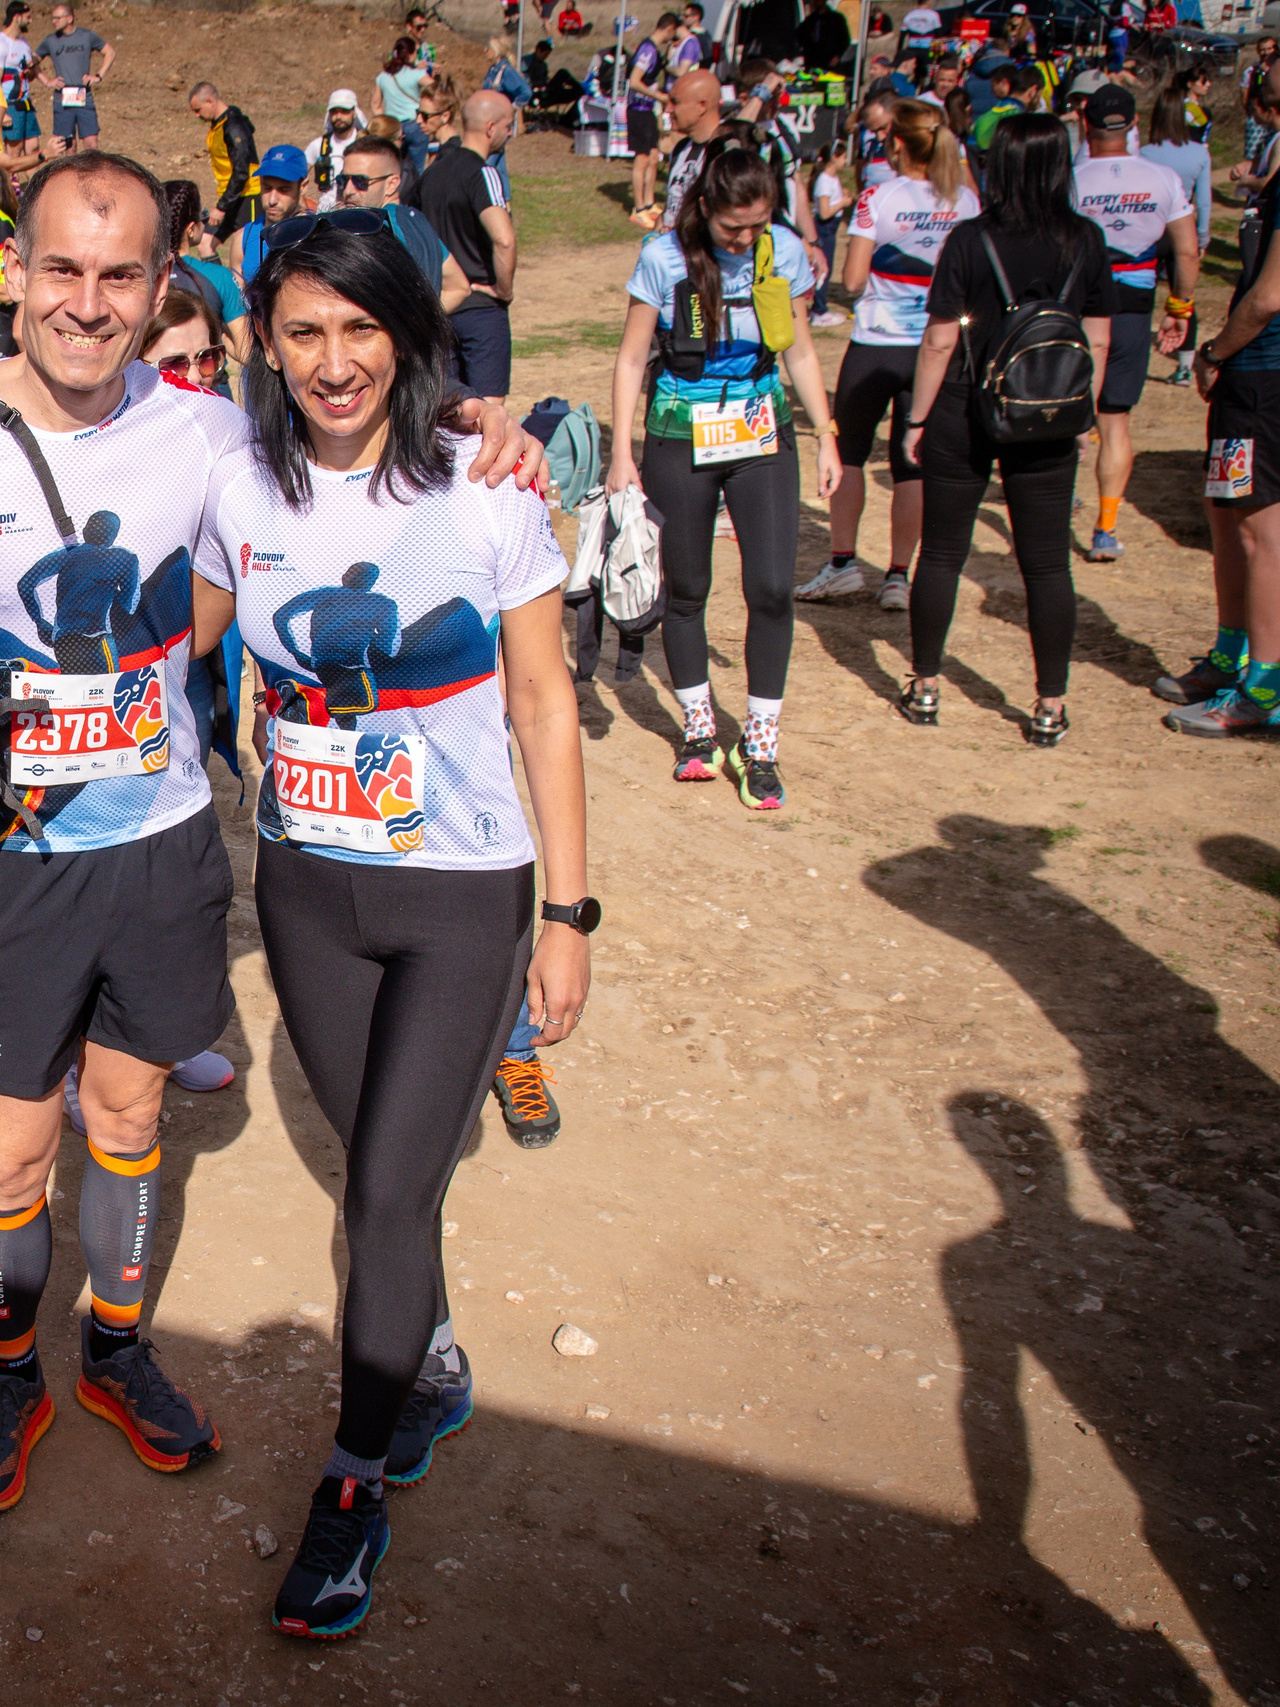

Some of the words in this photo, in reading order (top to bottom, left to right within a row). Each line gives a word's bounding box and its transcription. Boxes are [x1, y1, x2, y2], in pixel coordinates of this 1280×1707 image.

[1081, 194, 1120, 207] EVERY
[1120, 192, 1151, 203] STEP
[1103, 203, 1158, 215] MATTERS
[895, 212, 932, 222] EVERY
[931, 211, 958, 221] STEP
[914, 222, 958, 231] MATTER
[74, 428, 98, 441] EVERY
[99, 418, 114, 431] STEP
[112, 394, 131, 421] MATTERS
[702, 421, 737, 446] 1115
[345, 470, 373, 482] EVERY
[253, 552, 285, 562] PLOVDIV
[252, 562, 271, 572] HILLS
[16, 712, 108, 751] 2378
[283, 736, 300, 745] PLOVDIV
[331, 744, 346, 752] 22K
[283, 742, 293, 750] HILLS
[276, 759, 347, 812] 2201
[131, 1182, 148, 1263] COMPRESSPORT
